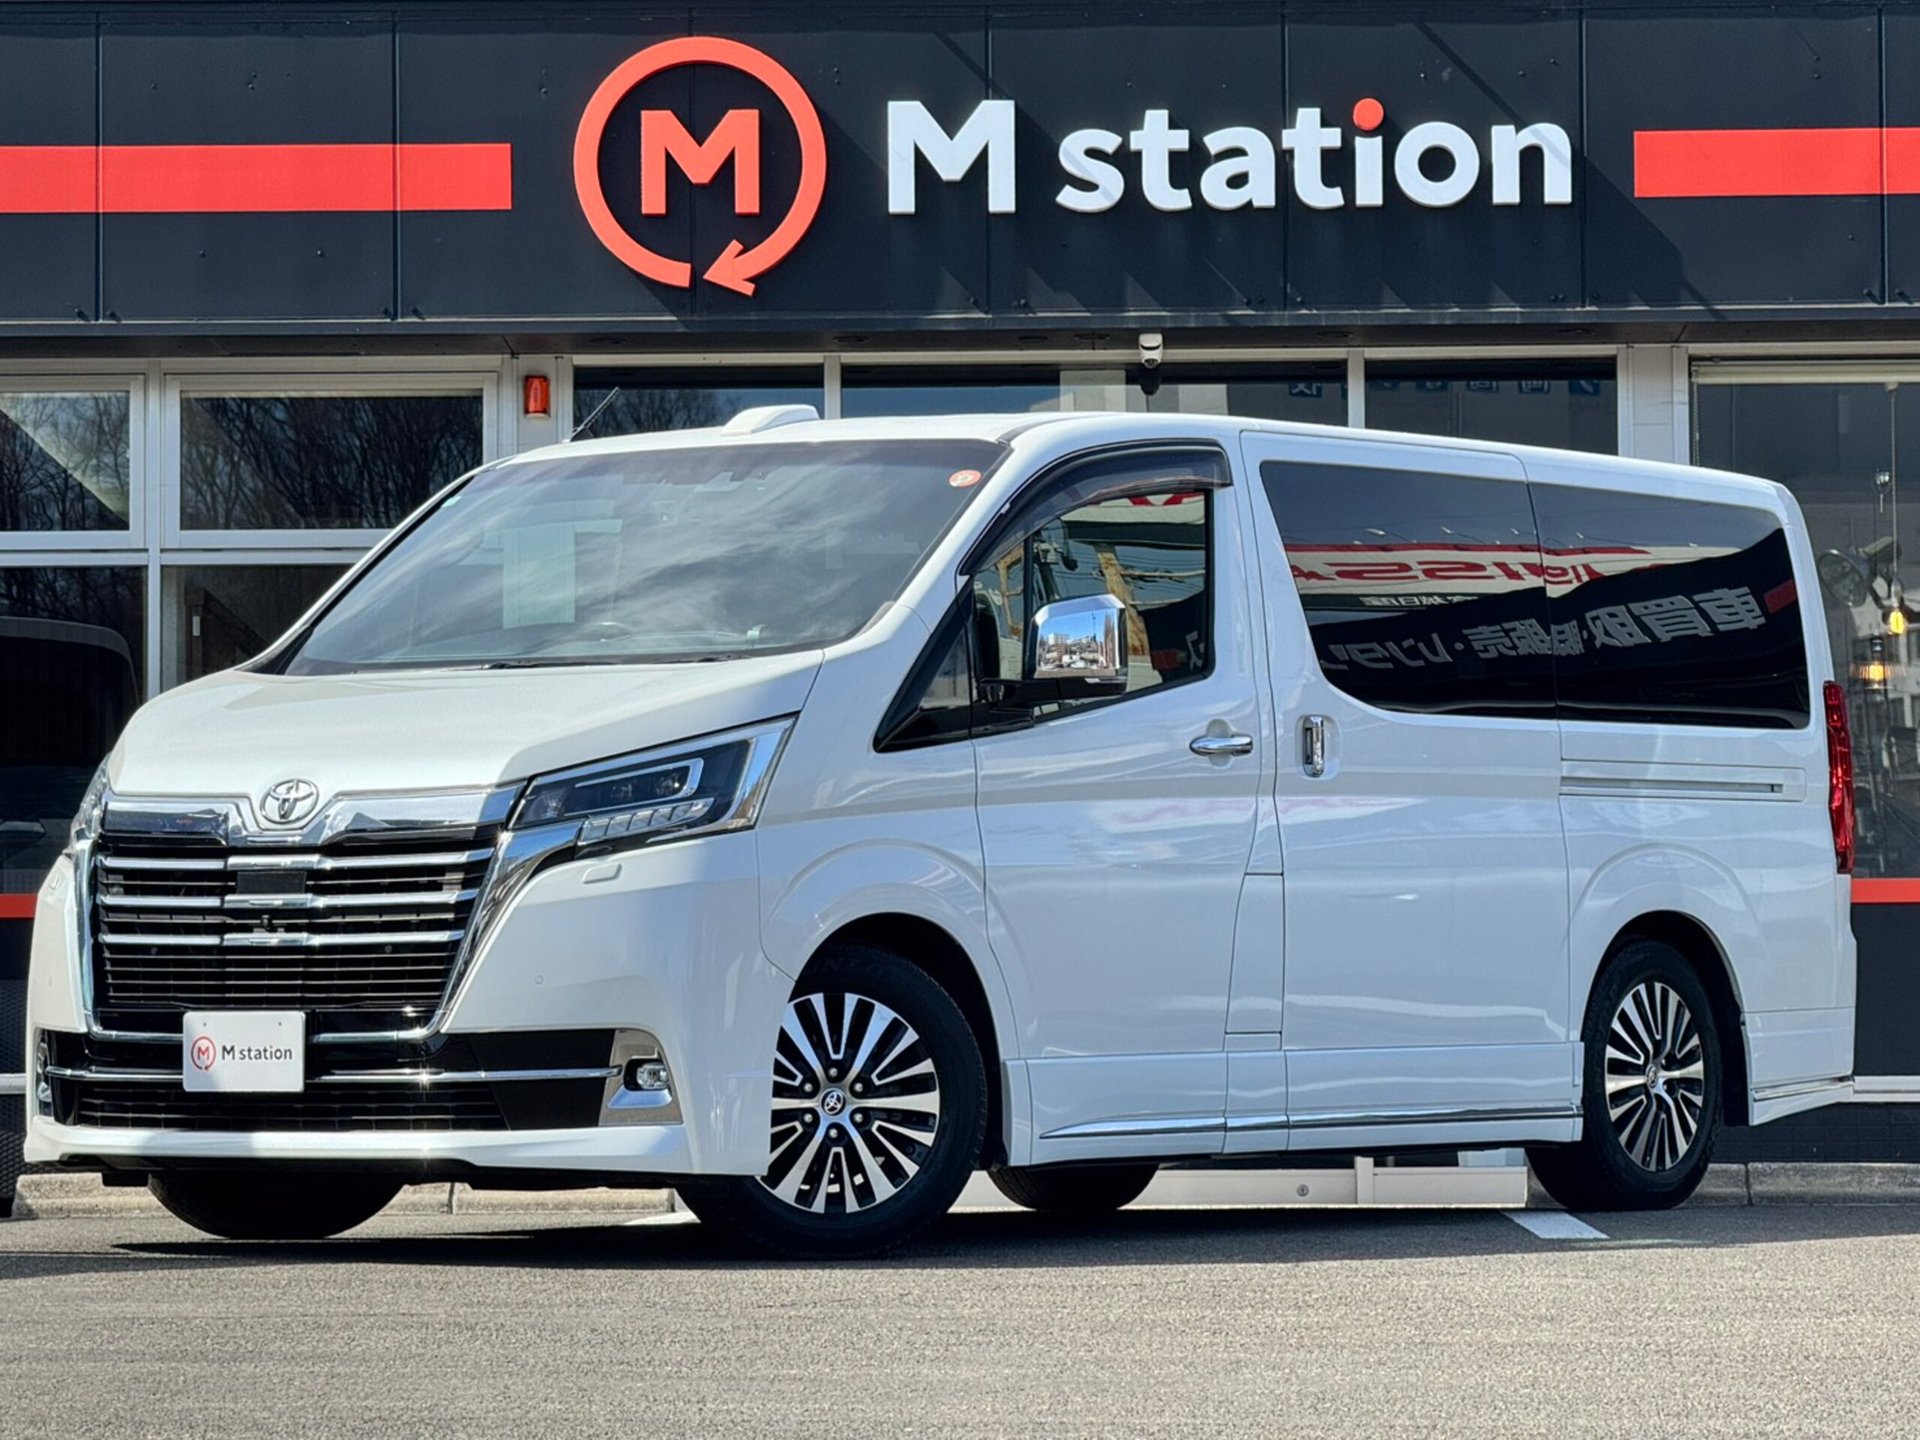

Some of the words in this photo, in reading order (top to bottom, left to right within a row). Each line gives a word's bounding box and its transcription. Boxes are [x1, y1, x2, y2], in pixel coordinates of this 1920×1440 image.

[641, 109, 760, 215] M
[888, 100, 1016, 214] M
[1055, 98, 1573, 212] station
[222, 1045, 235, 1060] M
[239, 1045, 293, 1061] station
